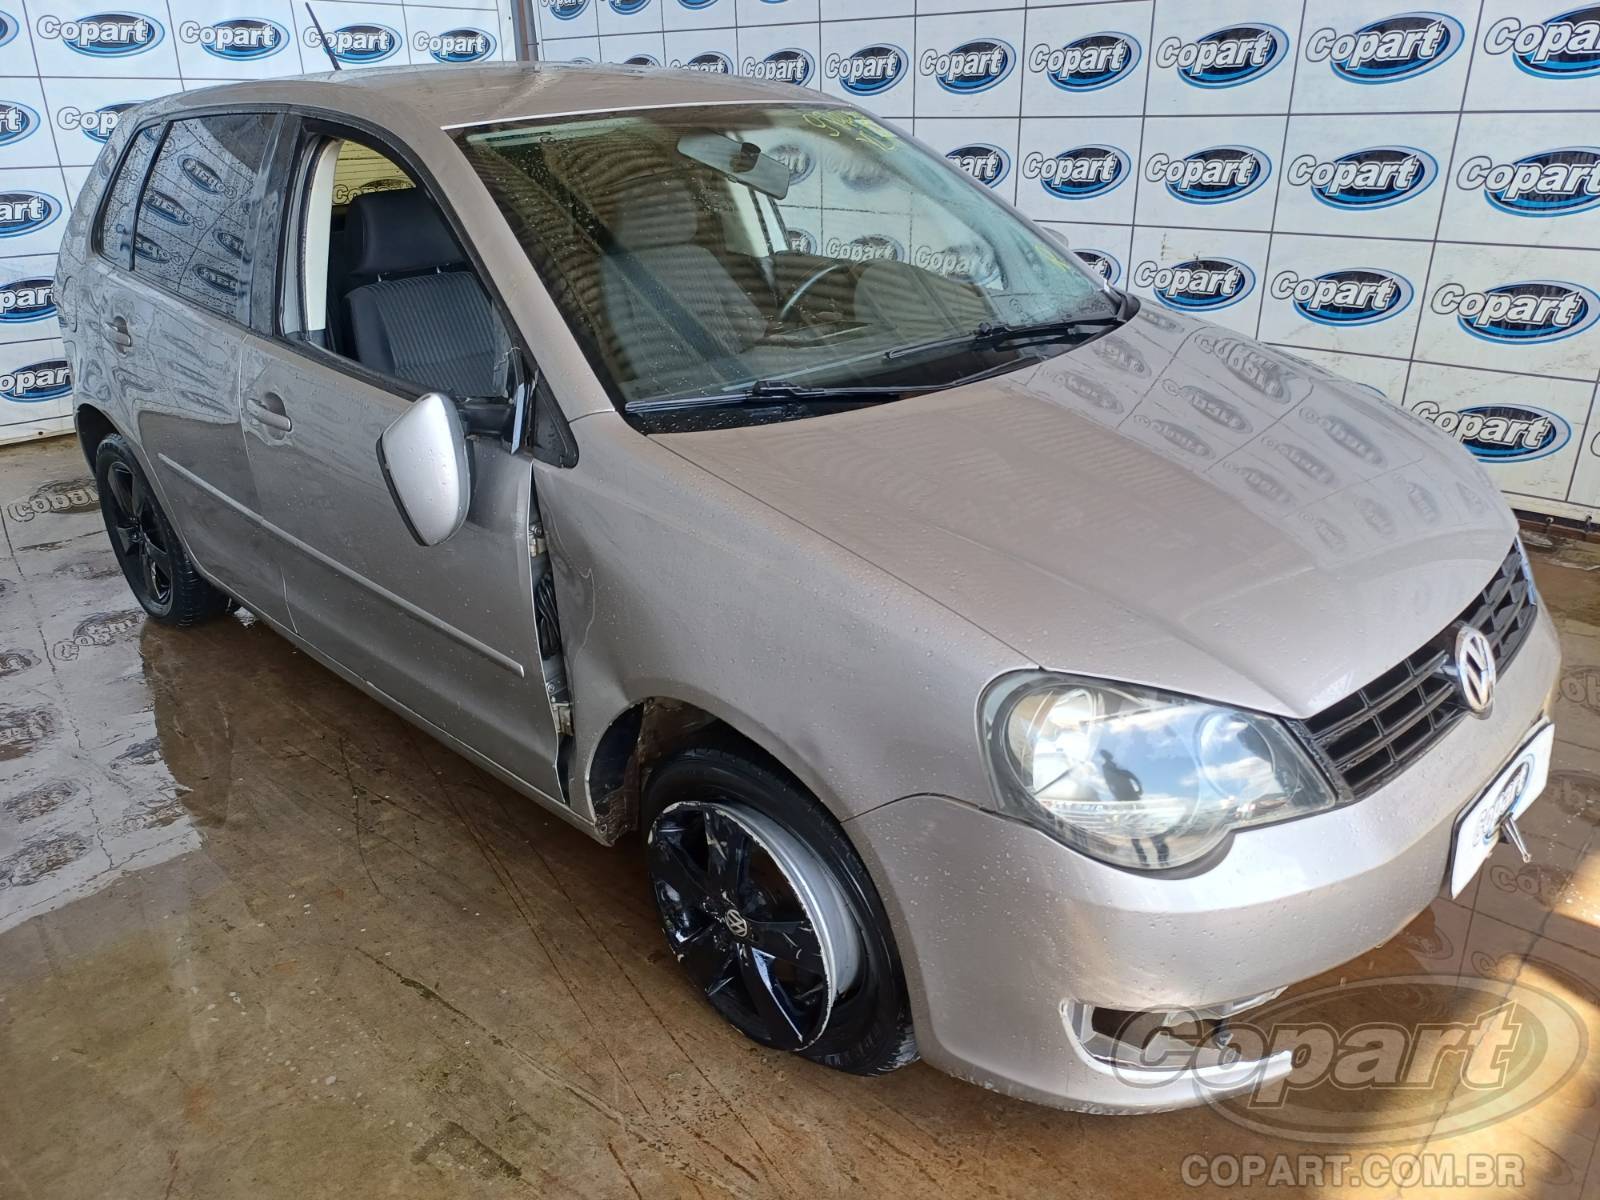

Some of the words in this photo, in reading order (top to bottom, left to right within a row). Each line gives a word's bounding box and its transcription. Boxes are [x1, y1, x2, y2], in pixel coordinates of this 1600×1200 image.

[37, 15, 148, 47] Copart
[179, 20, 276, 50] Copart
[303, 26, 389, 53] Copart
[413, 31, 485, 55] Copart
[1305, 19, 1445, 62] Copart
[1484, 17, 1600, 63] Copa
[742, 54, 804, 81] Copart
[825, 51, 898, 84] Copart
[920, 45, 1003, 83] Copart
[1030, 38, 1126, 80] Copart
[1156, 32, 1271, 75] Copart
[57, 106, 119, 136] Cop
[1023, 151, 1117, 185] Copart
[1145, 153, 1256, 190] Copart
[1287, 154, 1420, 194] Copart
[0, 196, 44, 222] art
[1134, 260, 1240, 297] Copart
[1271, 271, 1397, 311] Copart
[0, 284, 54, 314] par
[1431, 283, 1582, 327] Copart
[0, 367, 70, 396] opar
[1411, 401, 1549, 447] Copart
